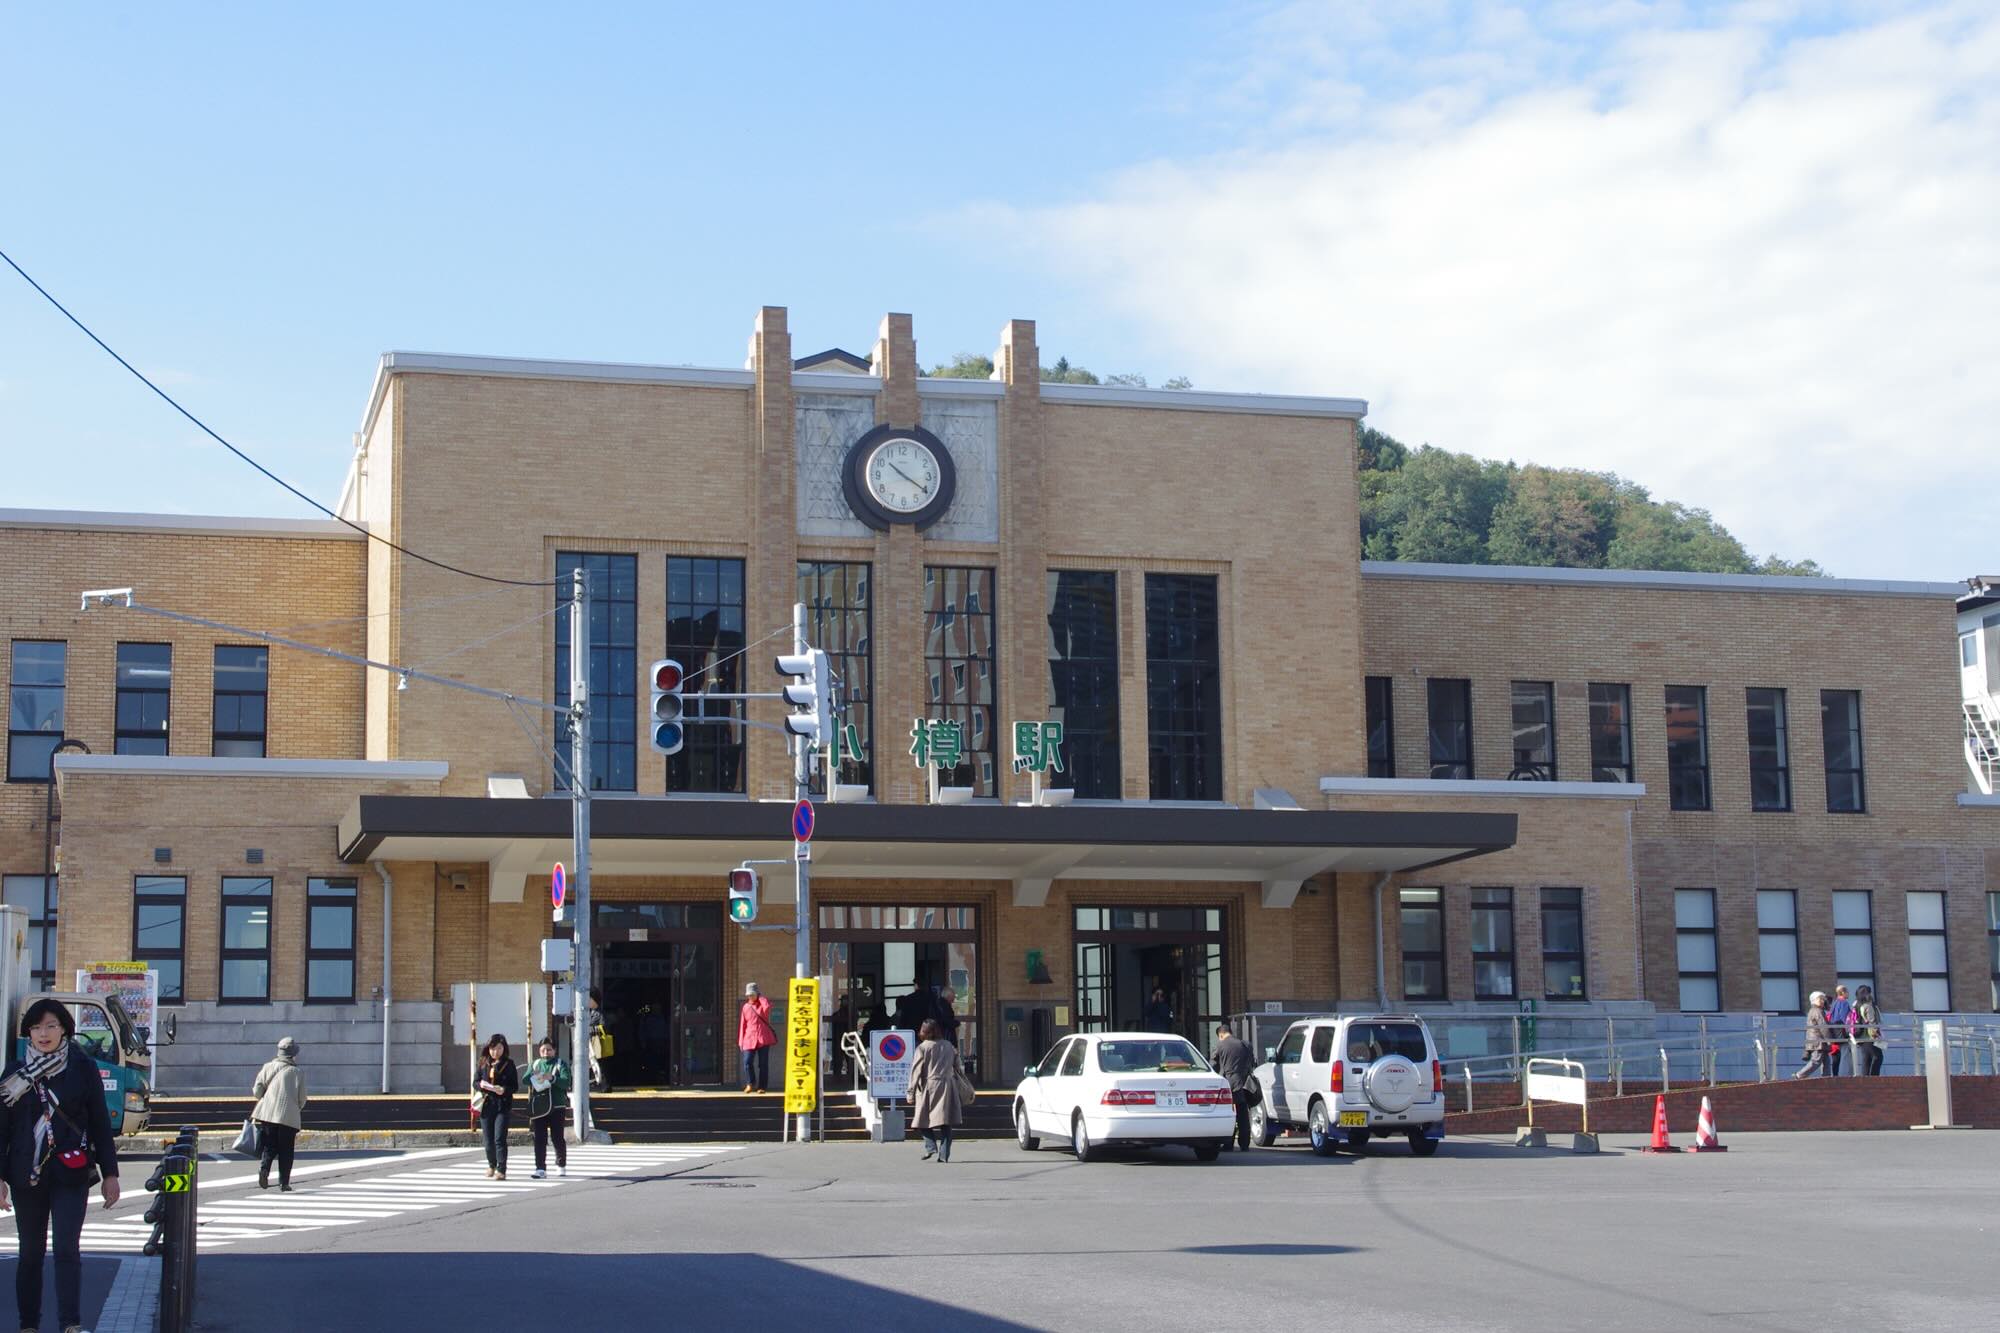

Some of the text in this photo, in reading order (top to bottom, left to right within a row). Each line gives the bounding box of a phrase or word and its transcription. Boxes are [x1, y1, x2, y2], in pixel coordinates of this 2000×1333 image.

[887, 448, 893, 458] 11
[898, 446, 908, 456] 12
[877, 458, 886, 468] 10
[922, 458, 928, 468] 2
[875, 470, 881, 480] 9
[925, 471, 932, 481] 3
[879, 484, 886, 493] 8
[889, 493, 895, 502] 7
[901, 496, 907, 506] 6
[913, 493, 919, 503] 5
[810, 716, 1064, 774] 小樽駅
